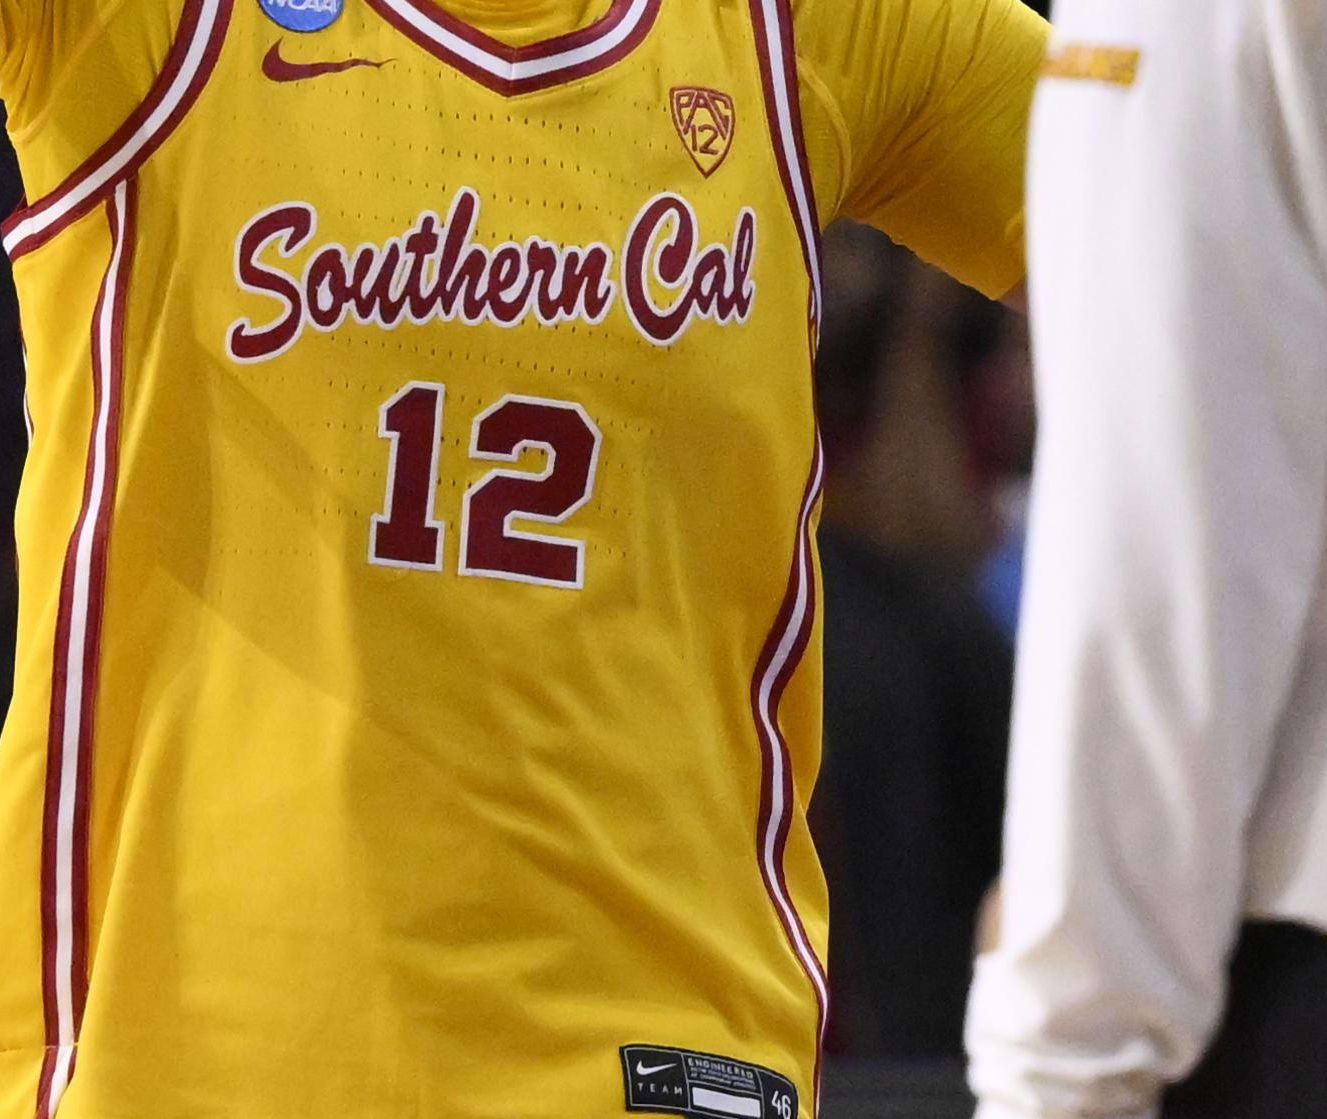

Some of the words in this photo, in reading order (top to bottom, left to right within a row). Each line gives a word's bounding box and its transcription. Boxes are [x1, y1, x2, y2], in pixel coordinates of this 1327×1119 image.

[674, 88, 732, 140] PAC
[691, 124, 719, 155] 12
[226, 187, 615, 363] Southern
[622, 193, 756, 346] Cal
[368, 380, 602, 588] 12
[687, 1057, 754, 1079] ENGINEERED
[637, 1082, 683, 1096] TEAM
[771, 1090, 792, 1119] 46
